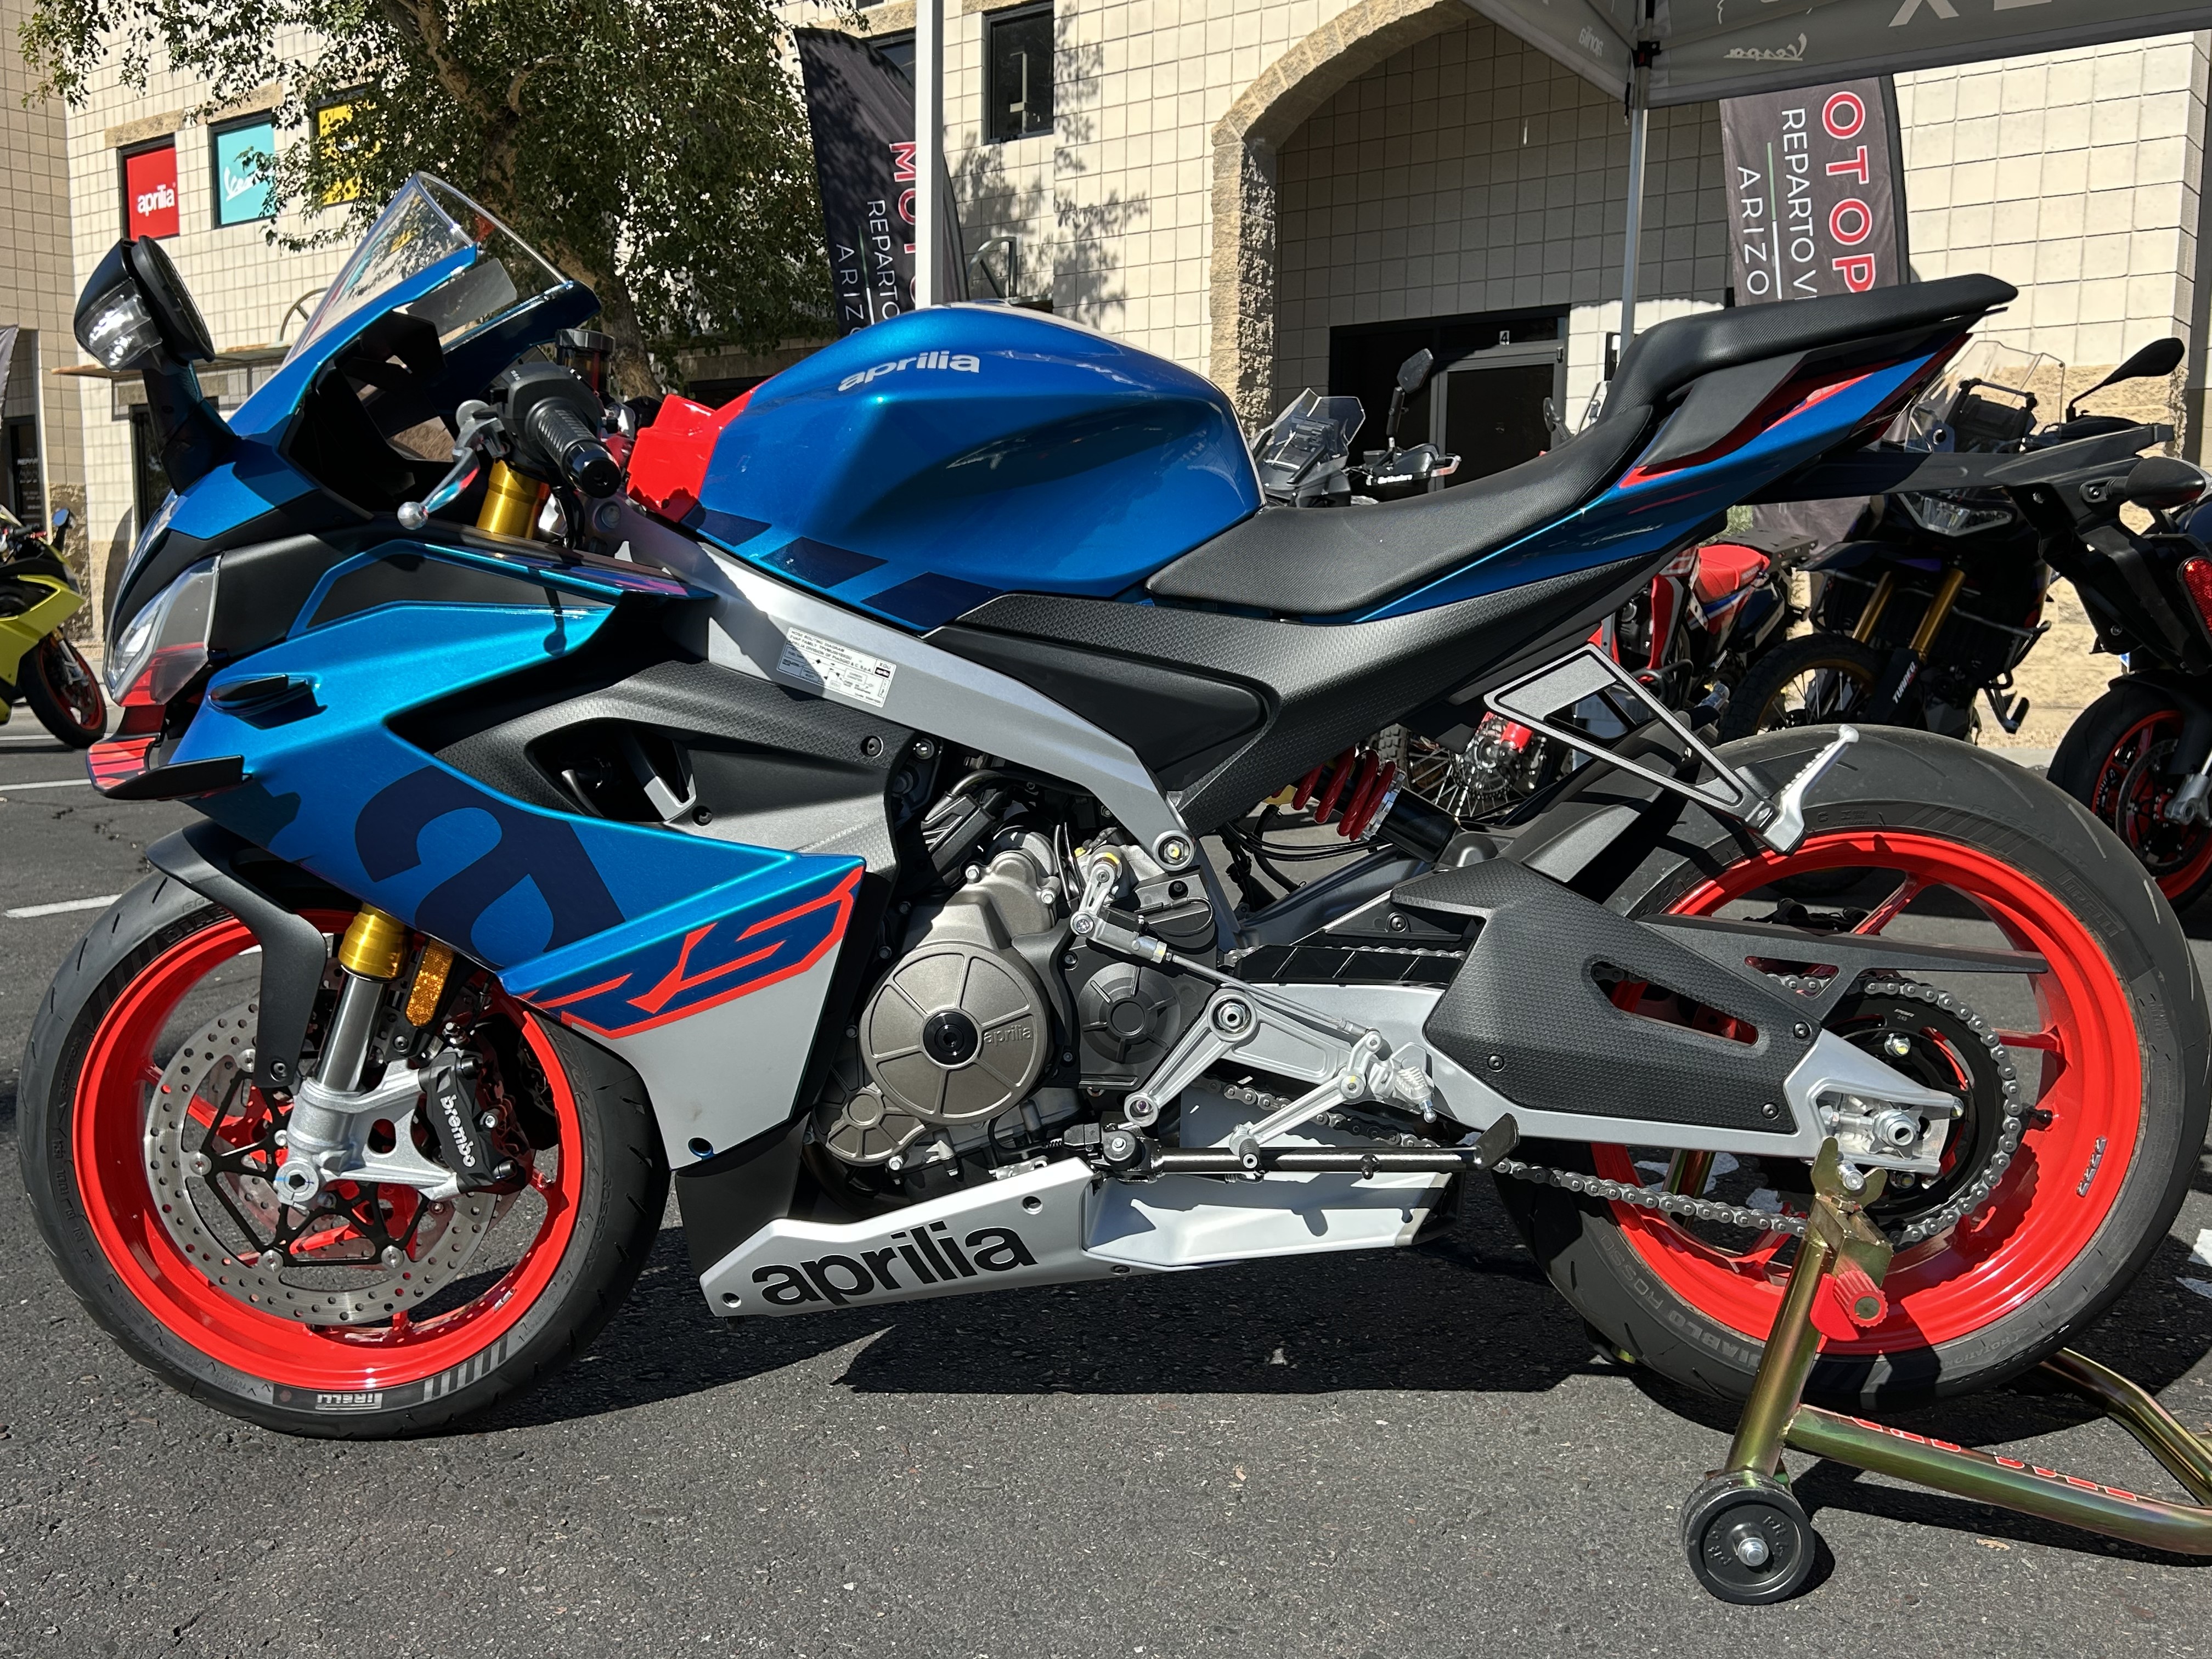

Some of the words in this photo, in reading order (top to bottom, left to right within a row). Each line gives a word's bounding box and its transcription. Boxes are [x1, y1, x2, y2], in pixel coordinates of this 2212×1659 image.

[137, 184, 175, 217] aprilia
[1781, 108, 1815, 262] REPARTO
[867, 200, 901, 320] REPARTO
[1737, 167, 1770, 295] ARIZO
[838, 350, 980, 392] aprilia
[1500, 332, 1509, 345] 4
[984, 1026, 1033, 1045] aprilia
[440, 1093, 477, 1169] brembo
[752, 1221, 1039, 1306] aprilia
